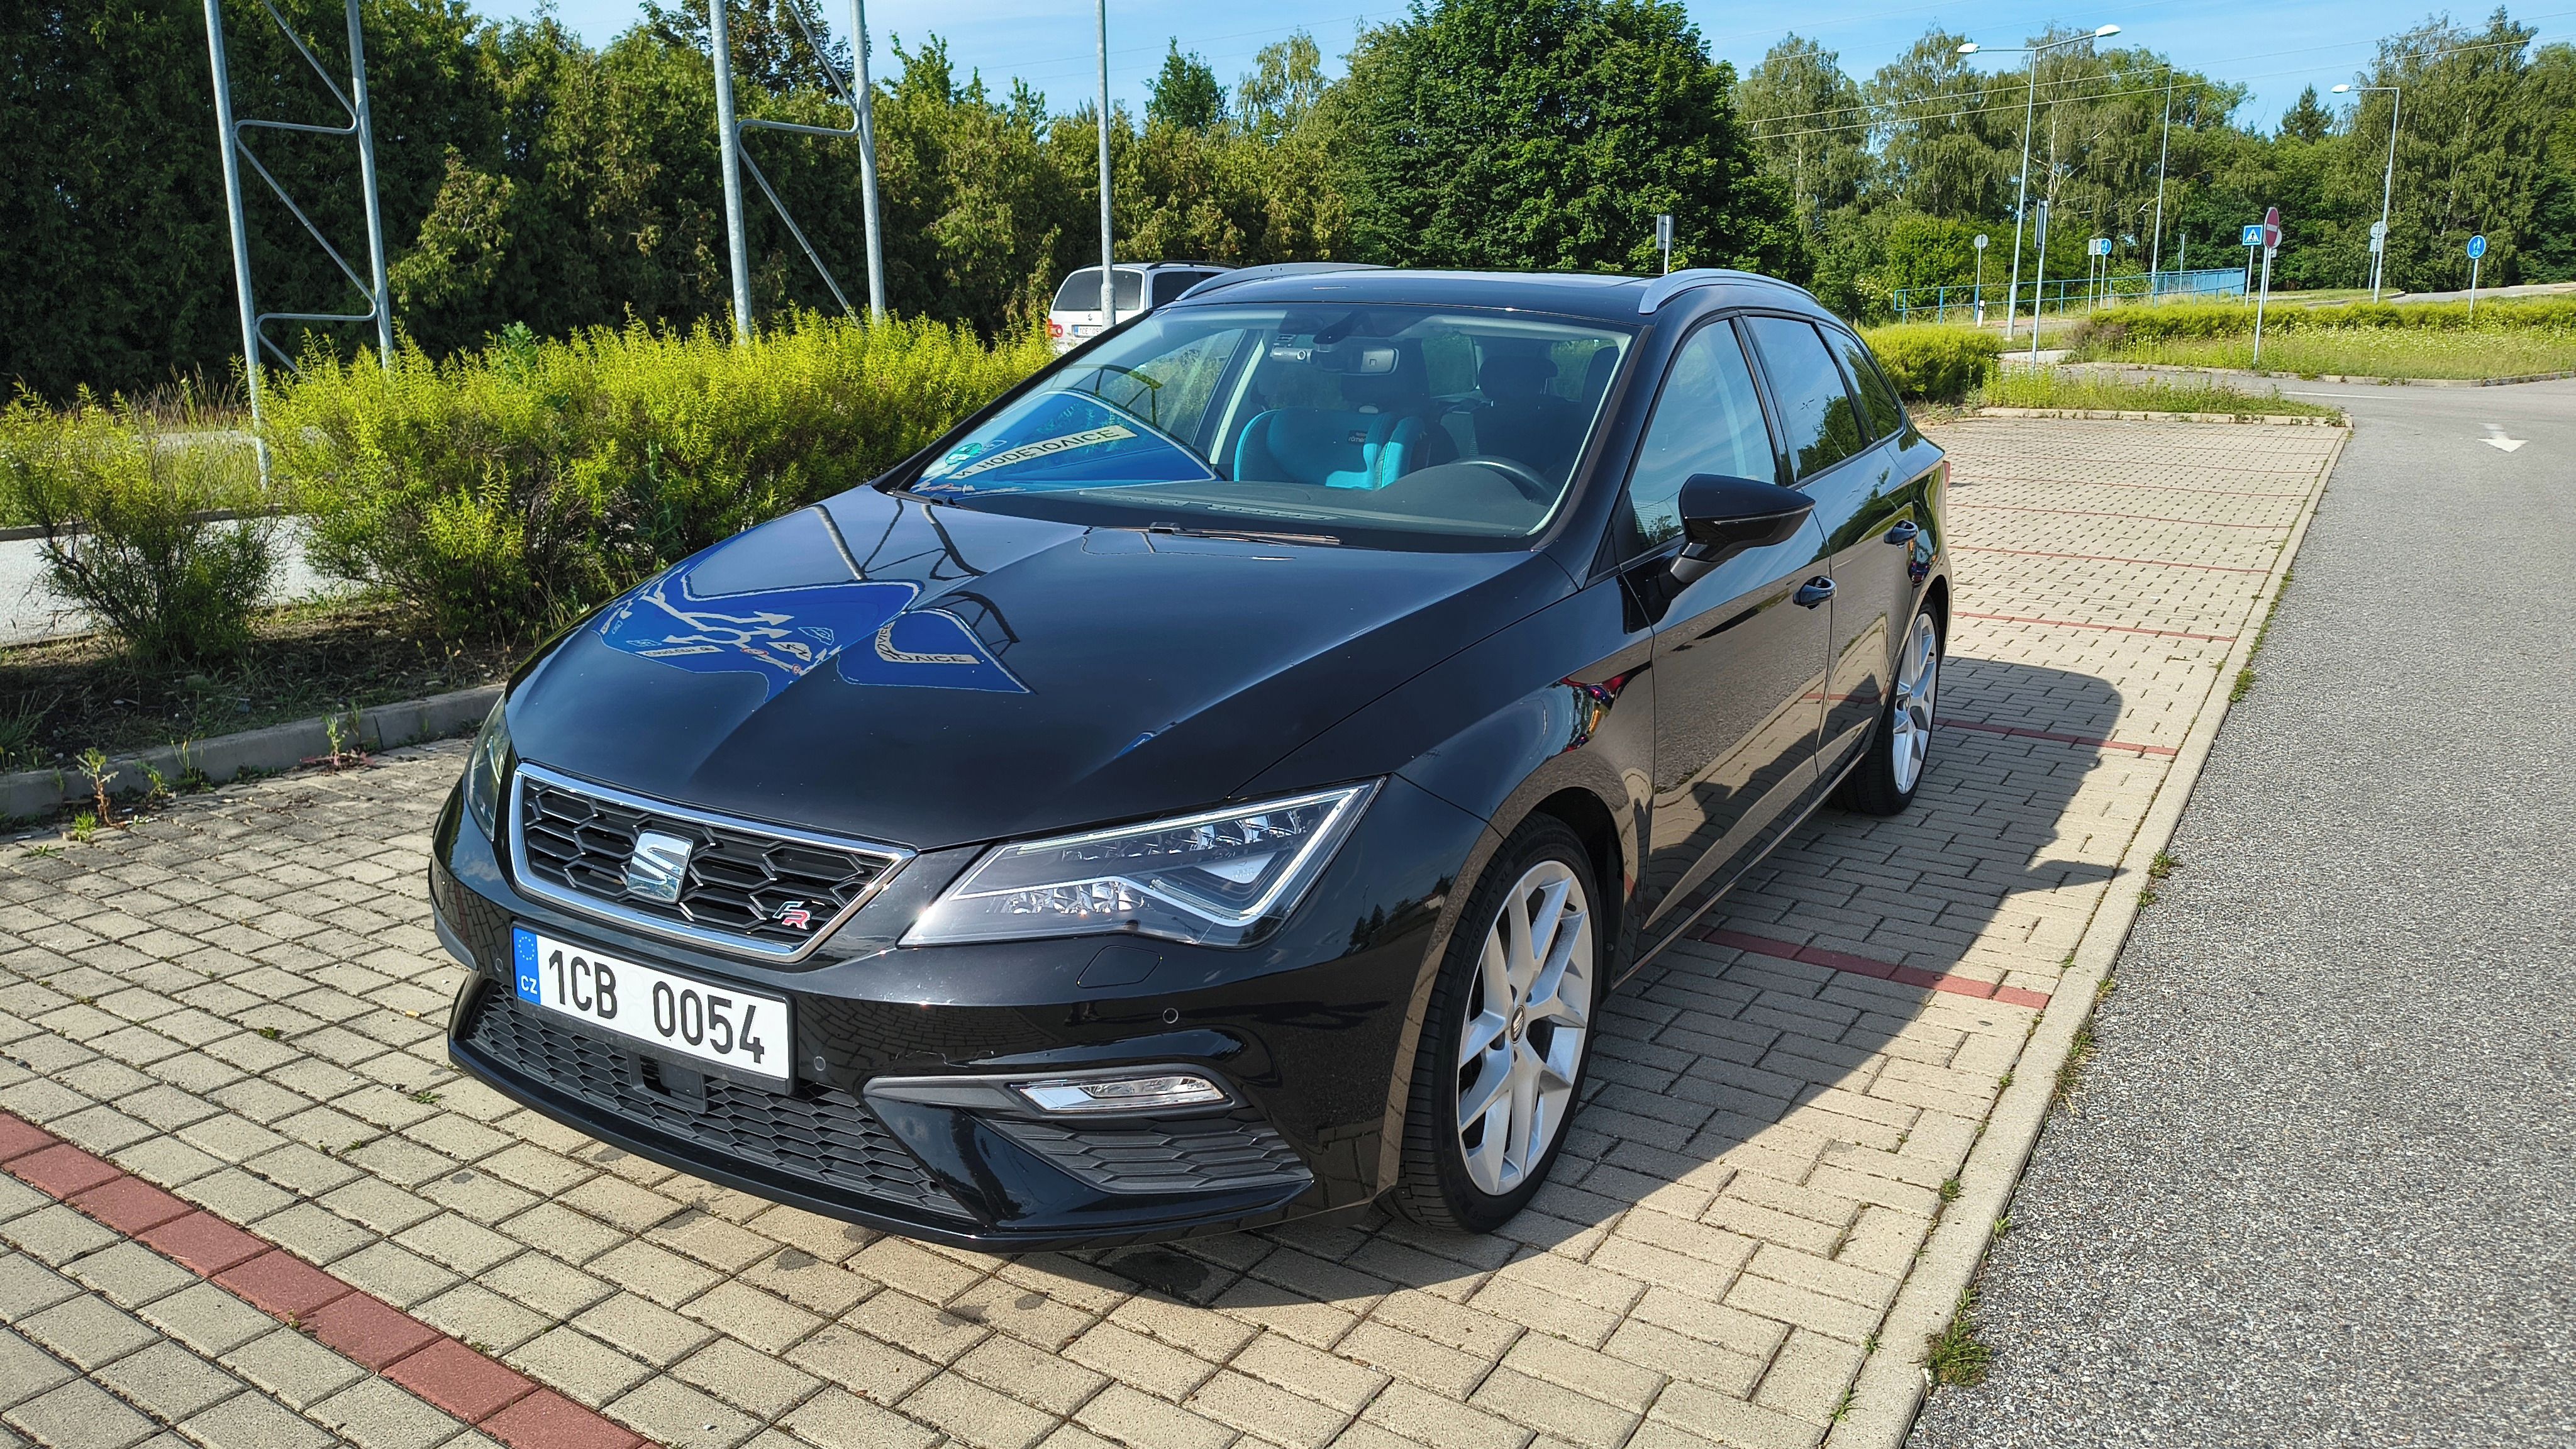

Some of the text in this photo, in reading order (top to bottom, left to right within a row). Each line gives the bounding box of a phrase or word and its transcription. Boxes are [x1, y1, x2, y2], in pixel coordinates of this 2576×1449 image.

[772, 901, 811, 930] FR
[521, 975, 538, 995] CZ
[549, 950, 765, 1064] 1CB 0054
